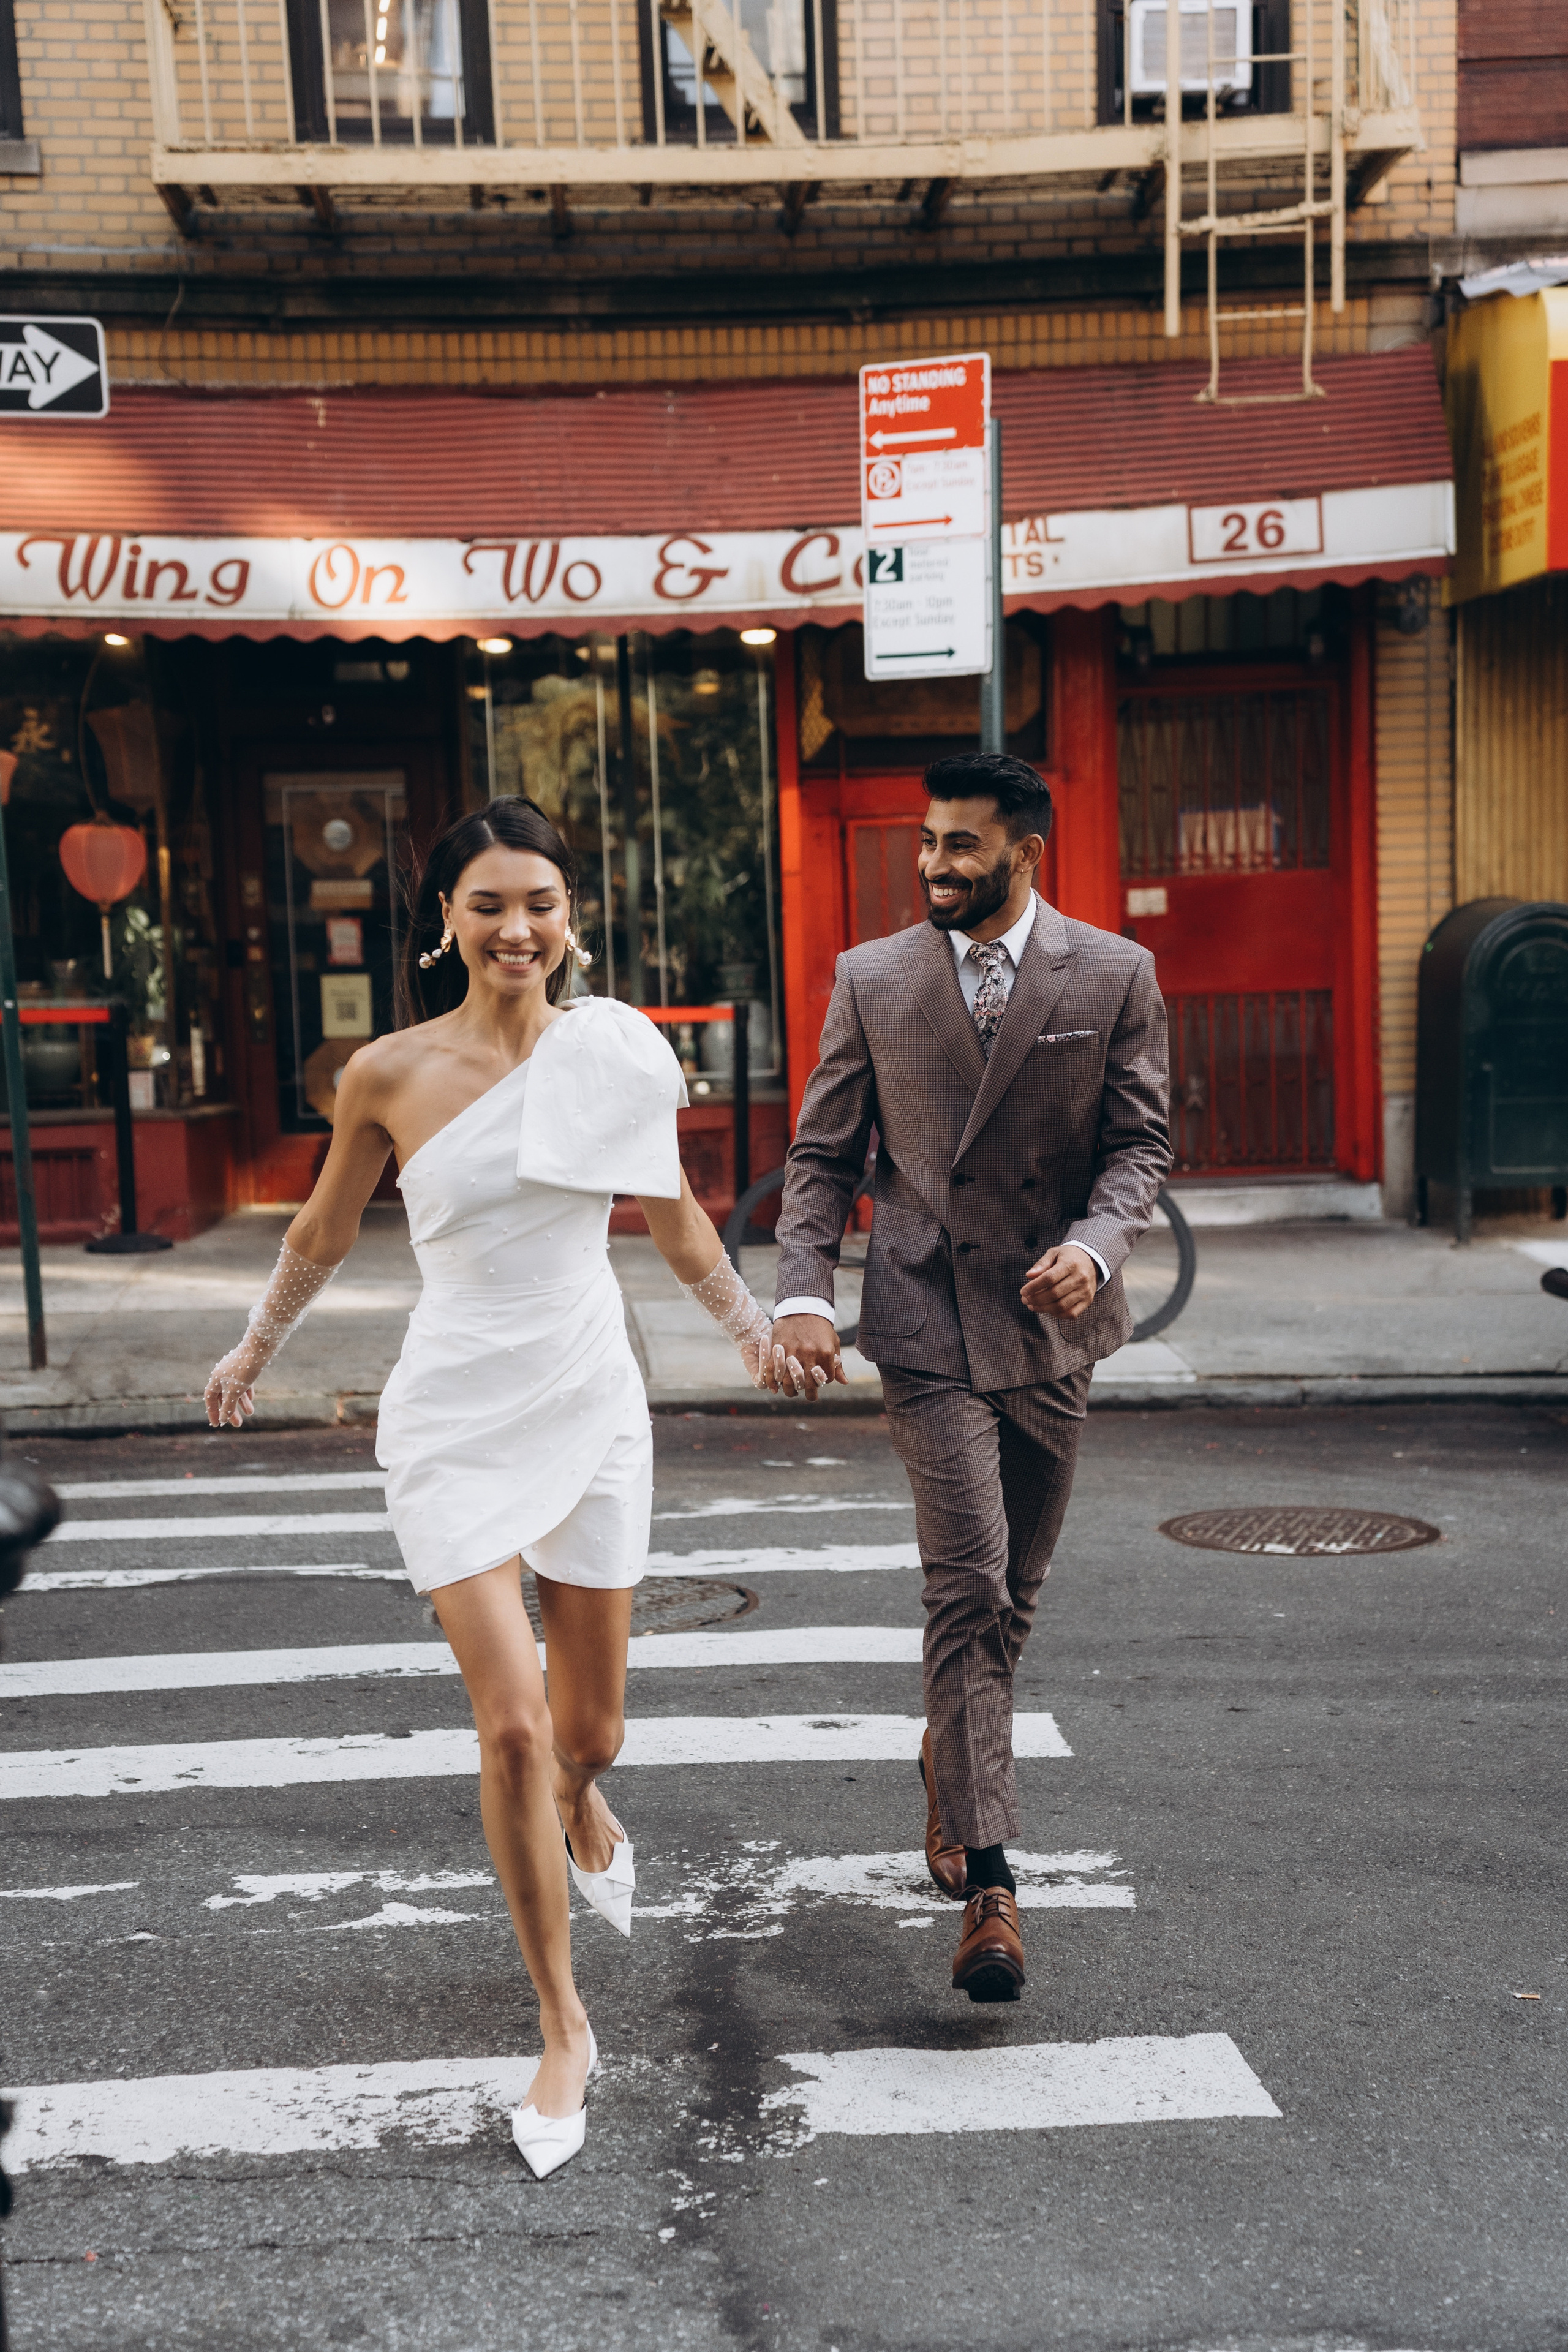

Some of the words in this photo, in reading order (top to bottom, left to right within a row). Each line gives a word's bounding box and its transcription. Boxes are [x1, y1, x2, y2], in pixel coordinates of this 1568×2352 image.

[0, 350, 60, 384] AY
[867, 374, 891, 395] NO
[892, 366, 967, 393] STANDING
[869, 394, 931, 418] Anytime
[1221, 509, 1287, 551] 26
[17, 535, 250, 606] Wing
[309, 544, 409, 609] On
[463, 541, 603, 603] Wo
[654, 532, 729, 600] &
[875, 547, 897, 582] 2
